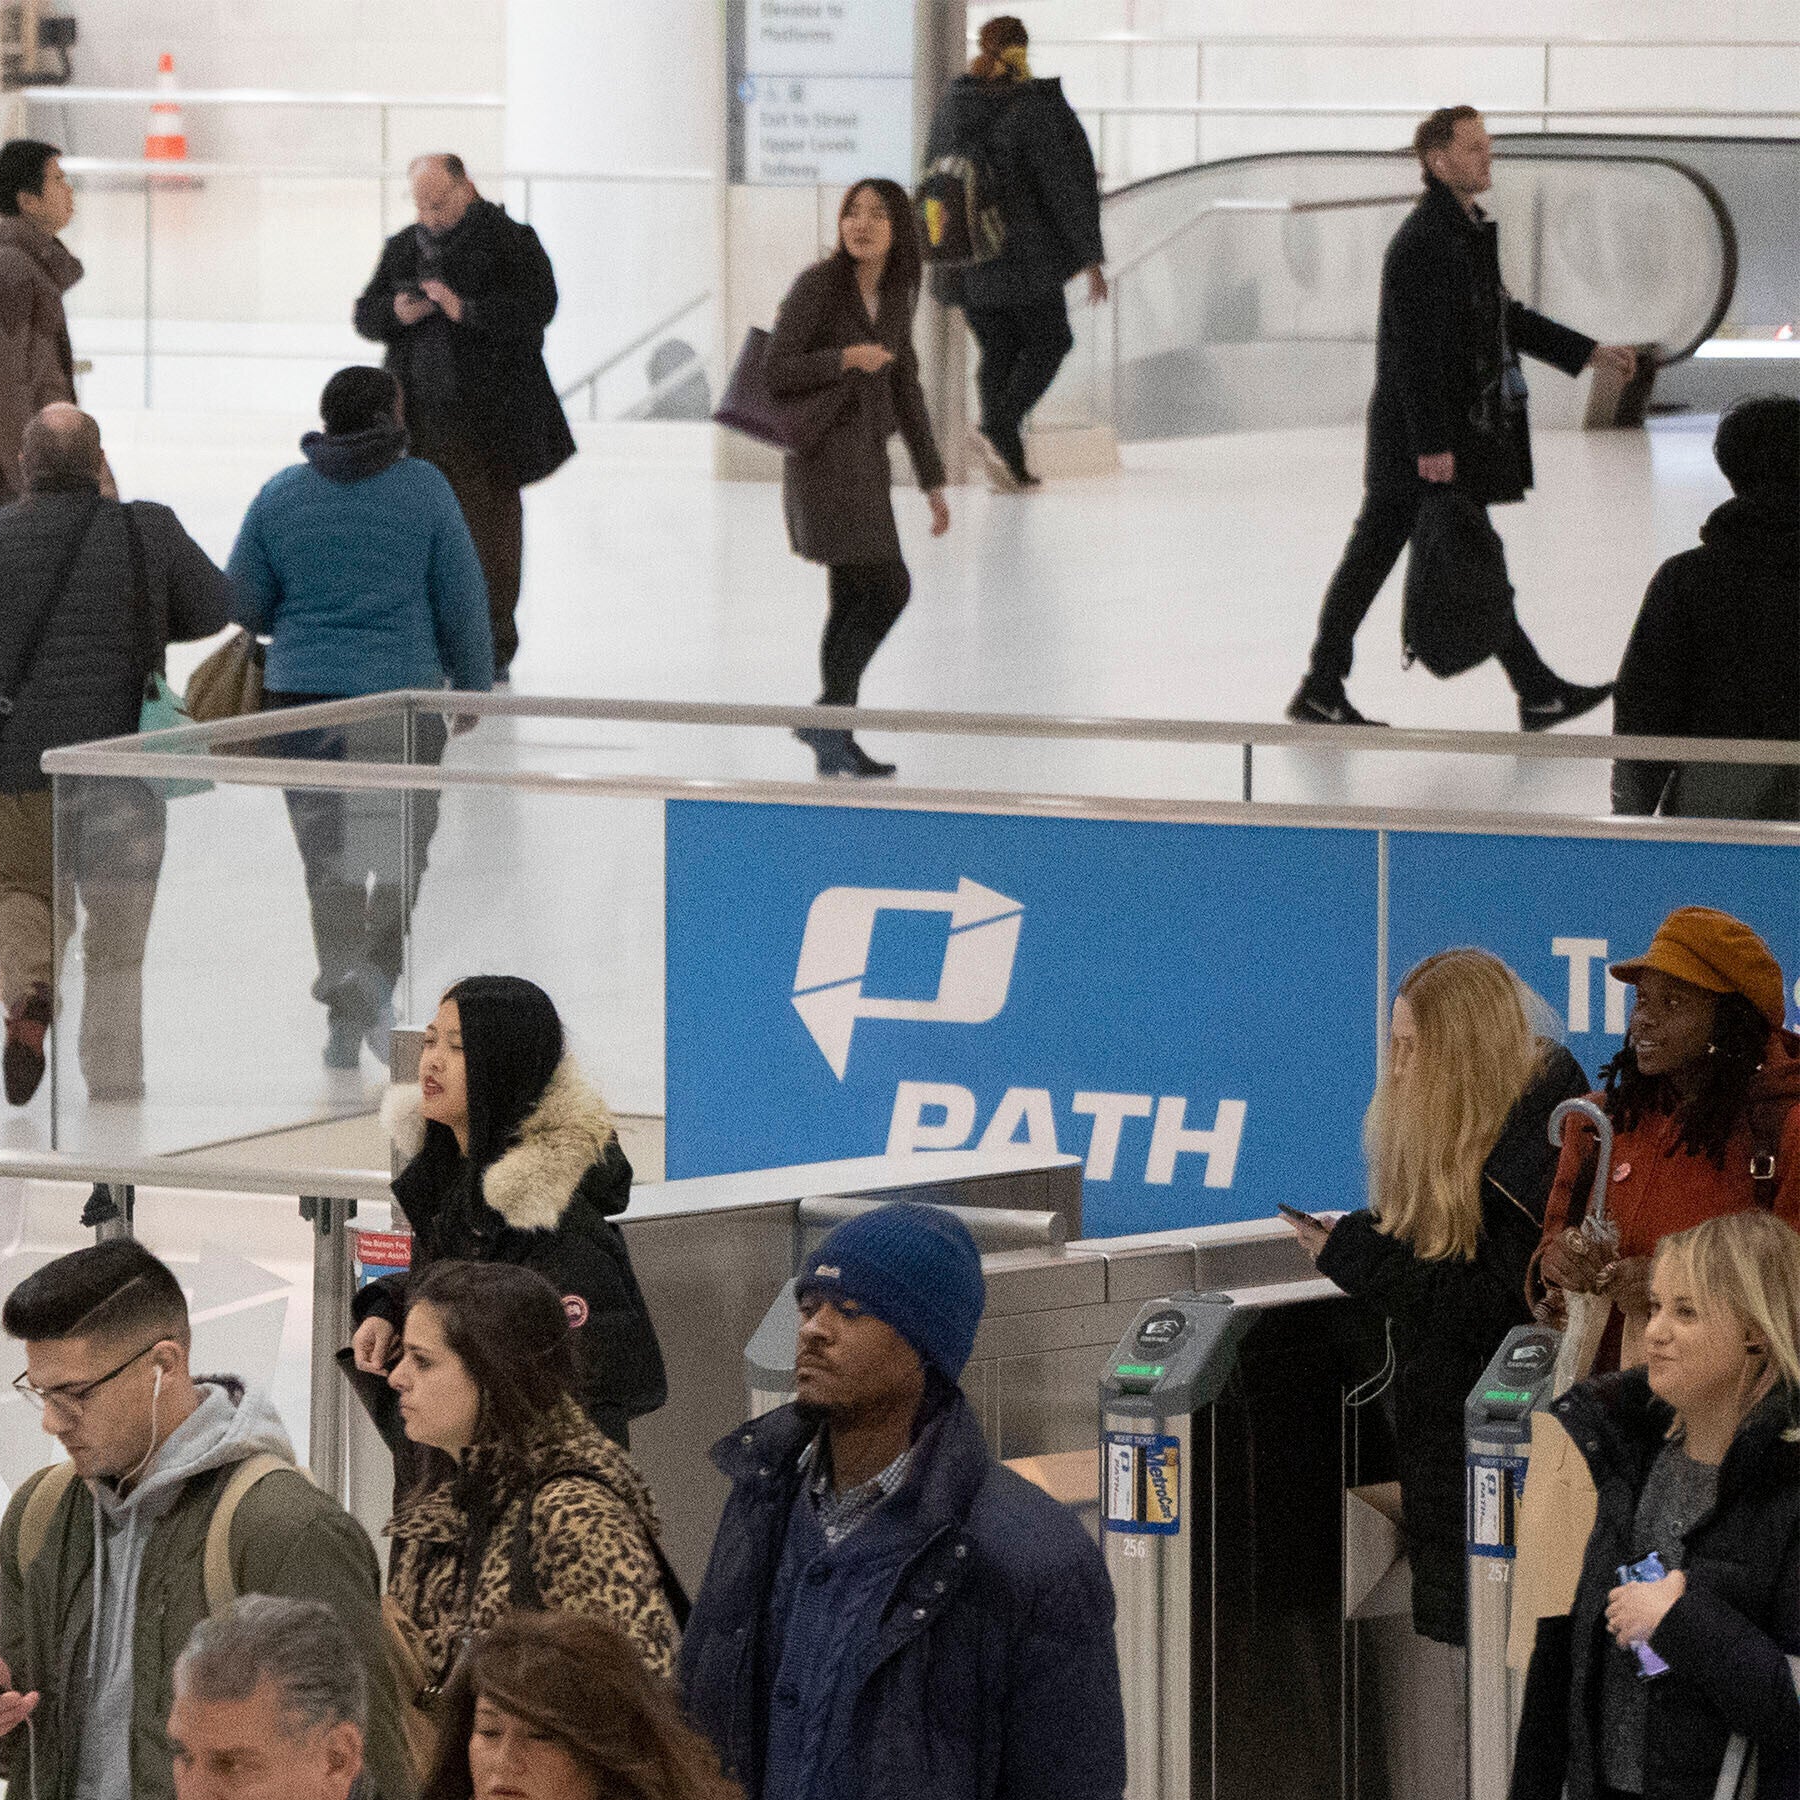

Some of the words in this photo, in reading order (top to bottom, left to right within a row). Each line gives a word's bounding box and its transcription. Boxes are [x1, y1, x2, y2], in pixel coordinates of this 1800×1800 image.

[885, 1080, 1248, 1189] PATH
[1123, 1537, 1147, 1558] 256
[1487, 1562, 1510, 1584] 257
